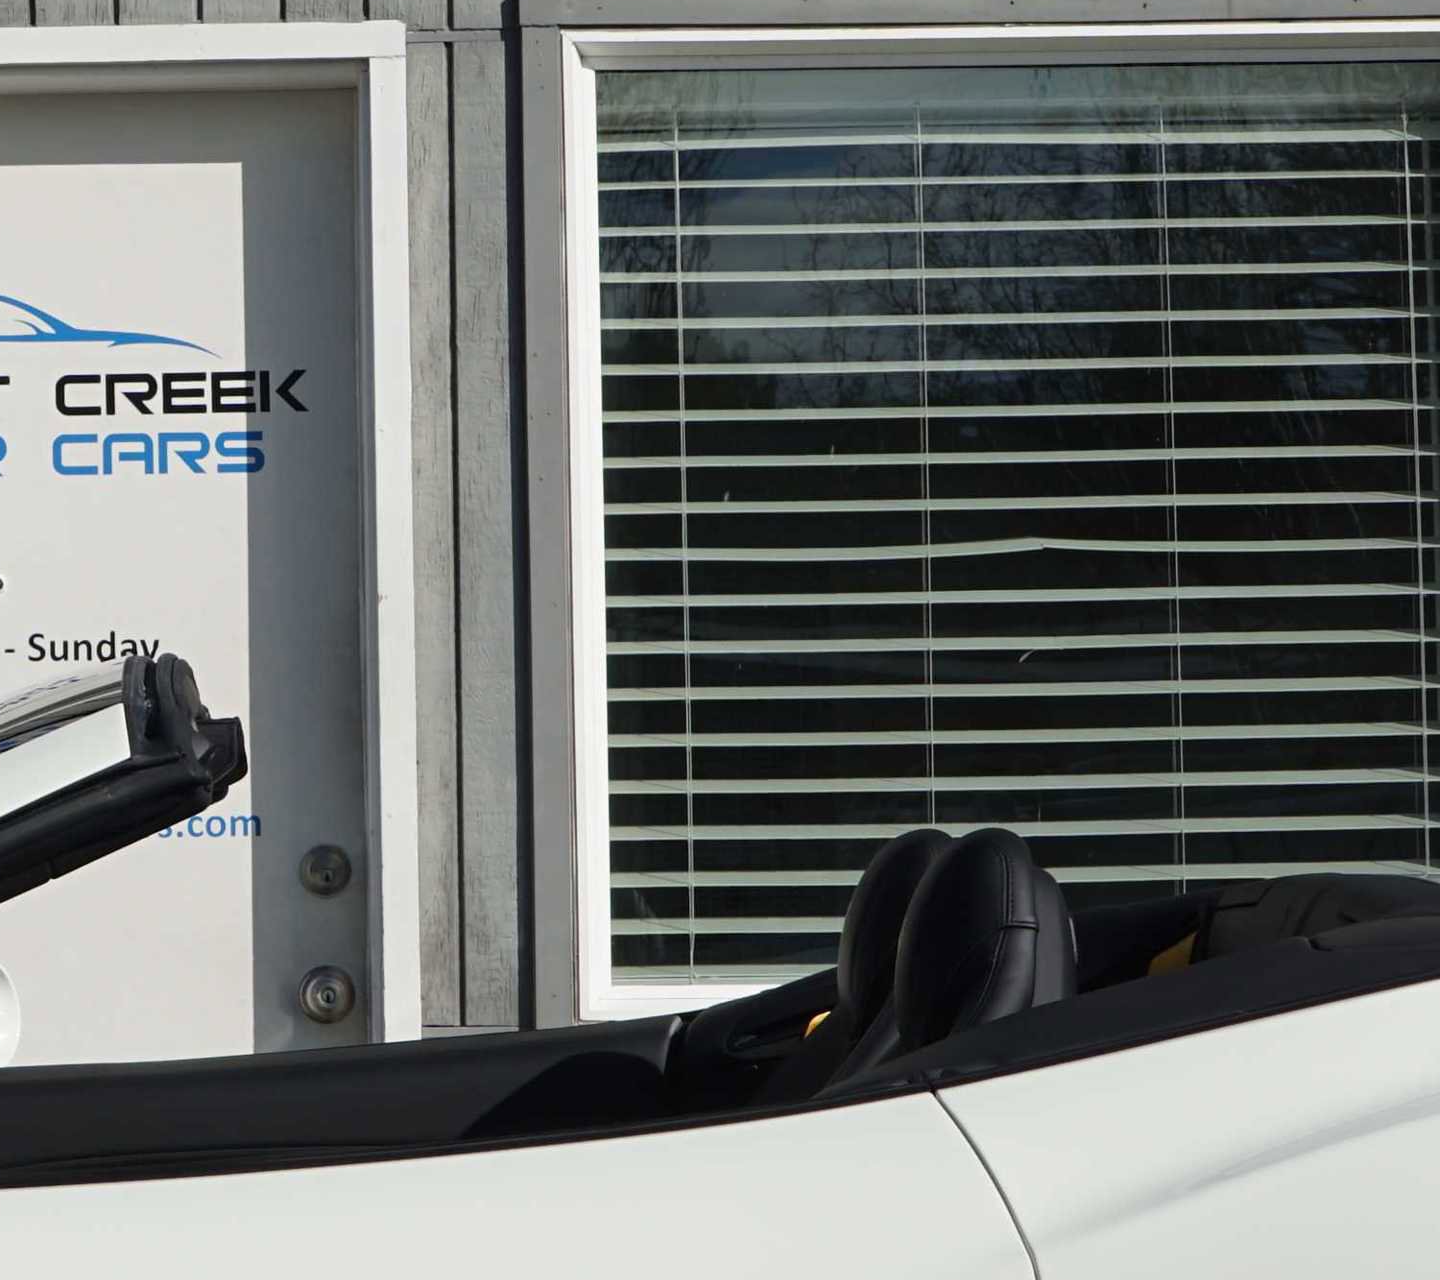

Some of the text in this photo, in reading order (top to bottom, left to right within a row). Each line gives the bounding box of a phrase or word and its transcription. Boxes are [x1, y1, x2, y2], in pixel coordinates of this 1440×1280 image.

[55, 368, 310, 416] CREEK
[51, 430, 266, 477] CARS
[28, 630, 160, 662] Sunday
